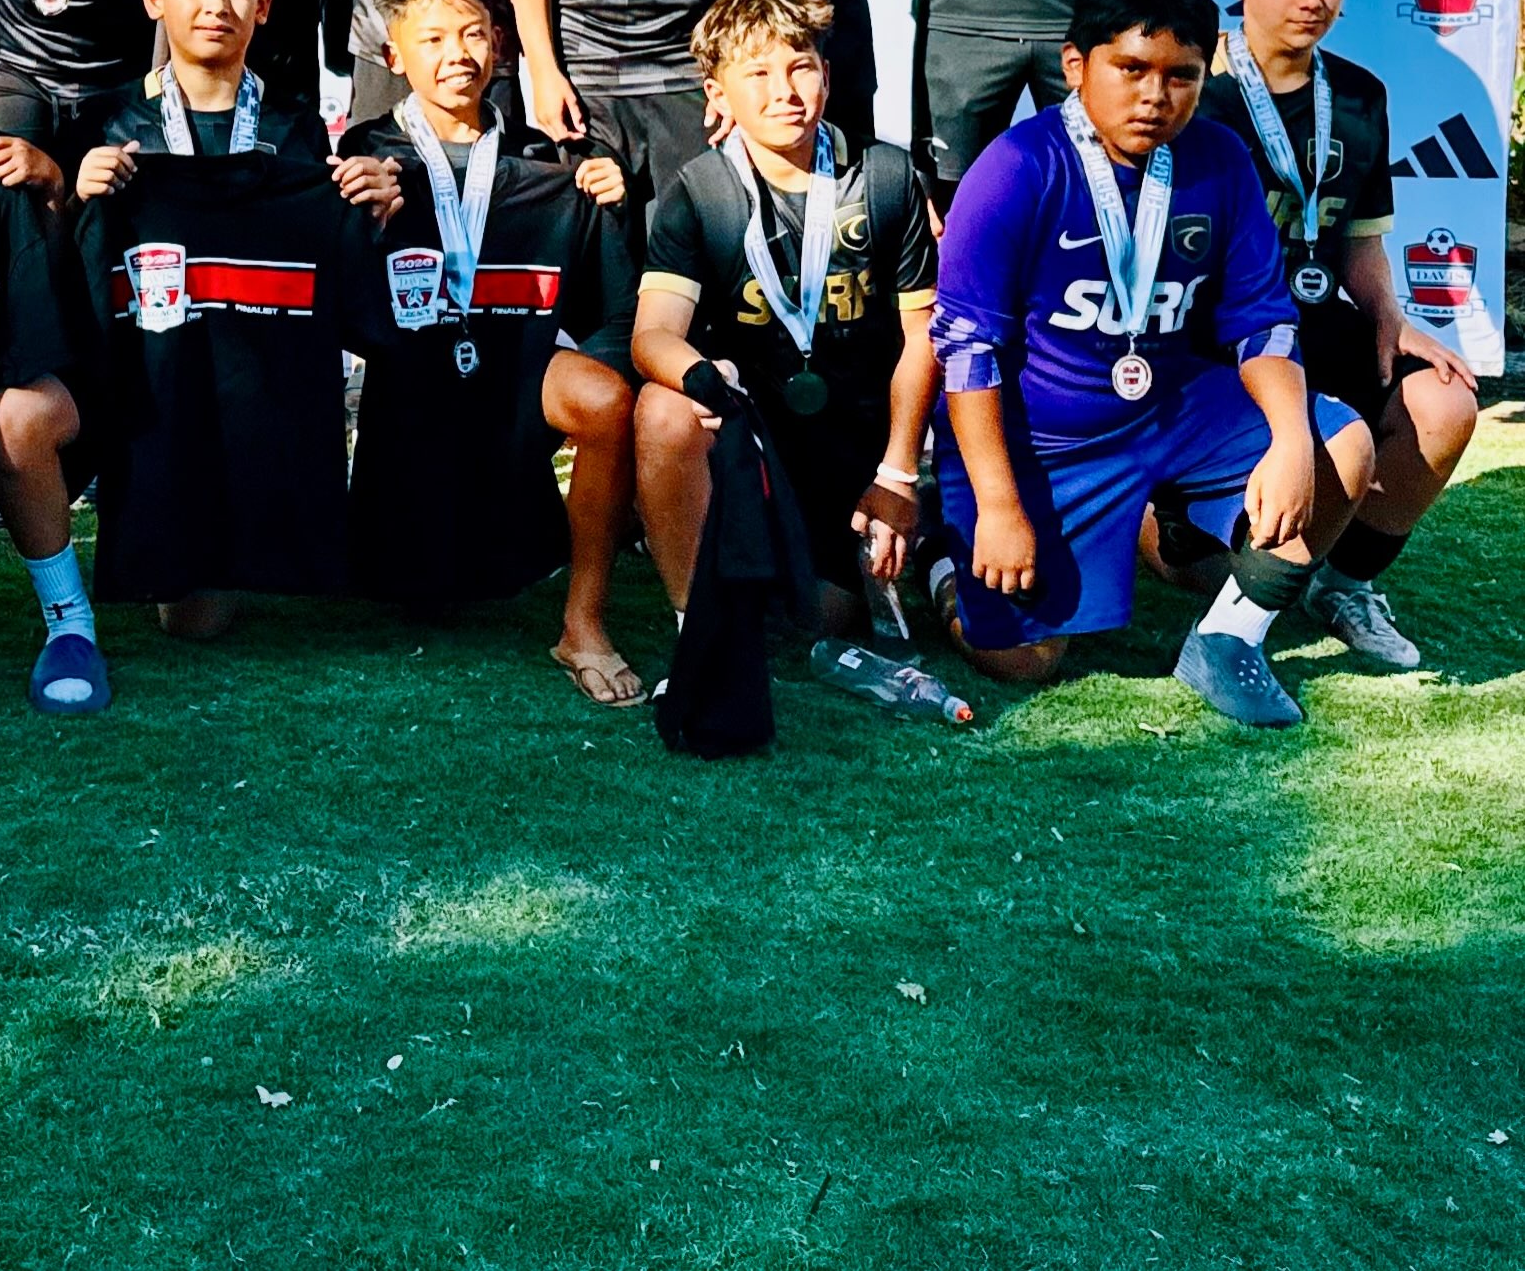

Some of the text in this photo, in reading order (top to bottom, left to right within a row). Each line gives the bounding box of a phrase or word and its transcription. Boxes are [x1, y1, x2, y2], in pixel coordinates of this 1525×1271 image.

[1420, 16, 1474, 24] LEGACY
[395, 259, 434, 269] 2026
[1416, 271, 1465, 281] DAVIS
[235, 304, 278, 315] FINALIST
[1413, 307, 1465, 315] LEGACY
